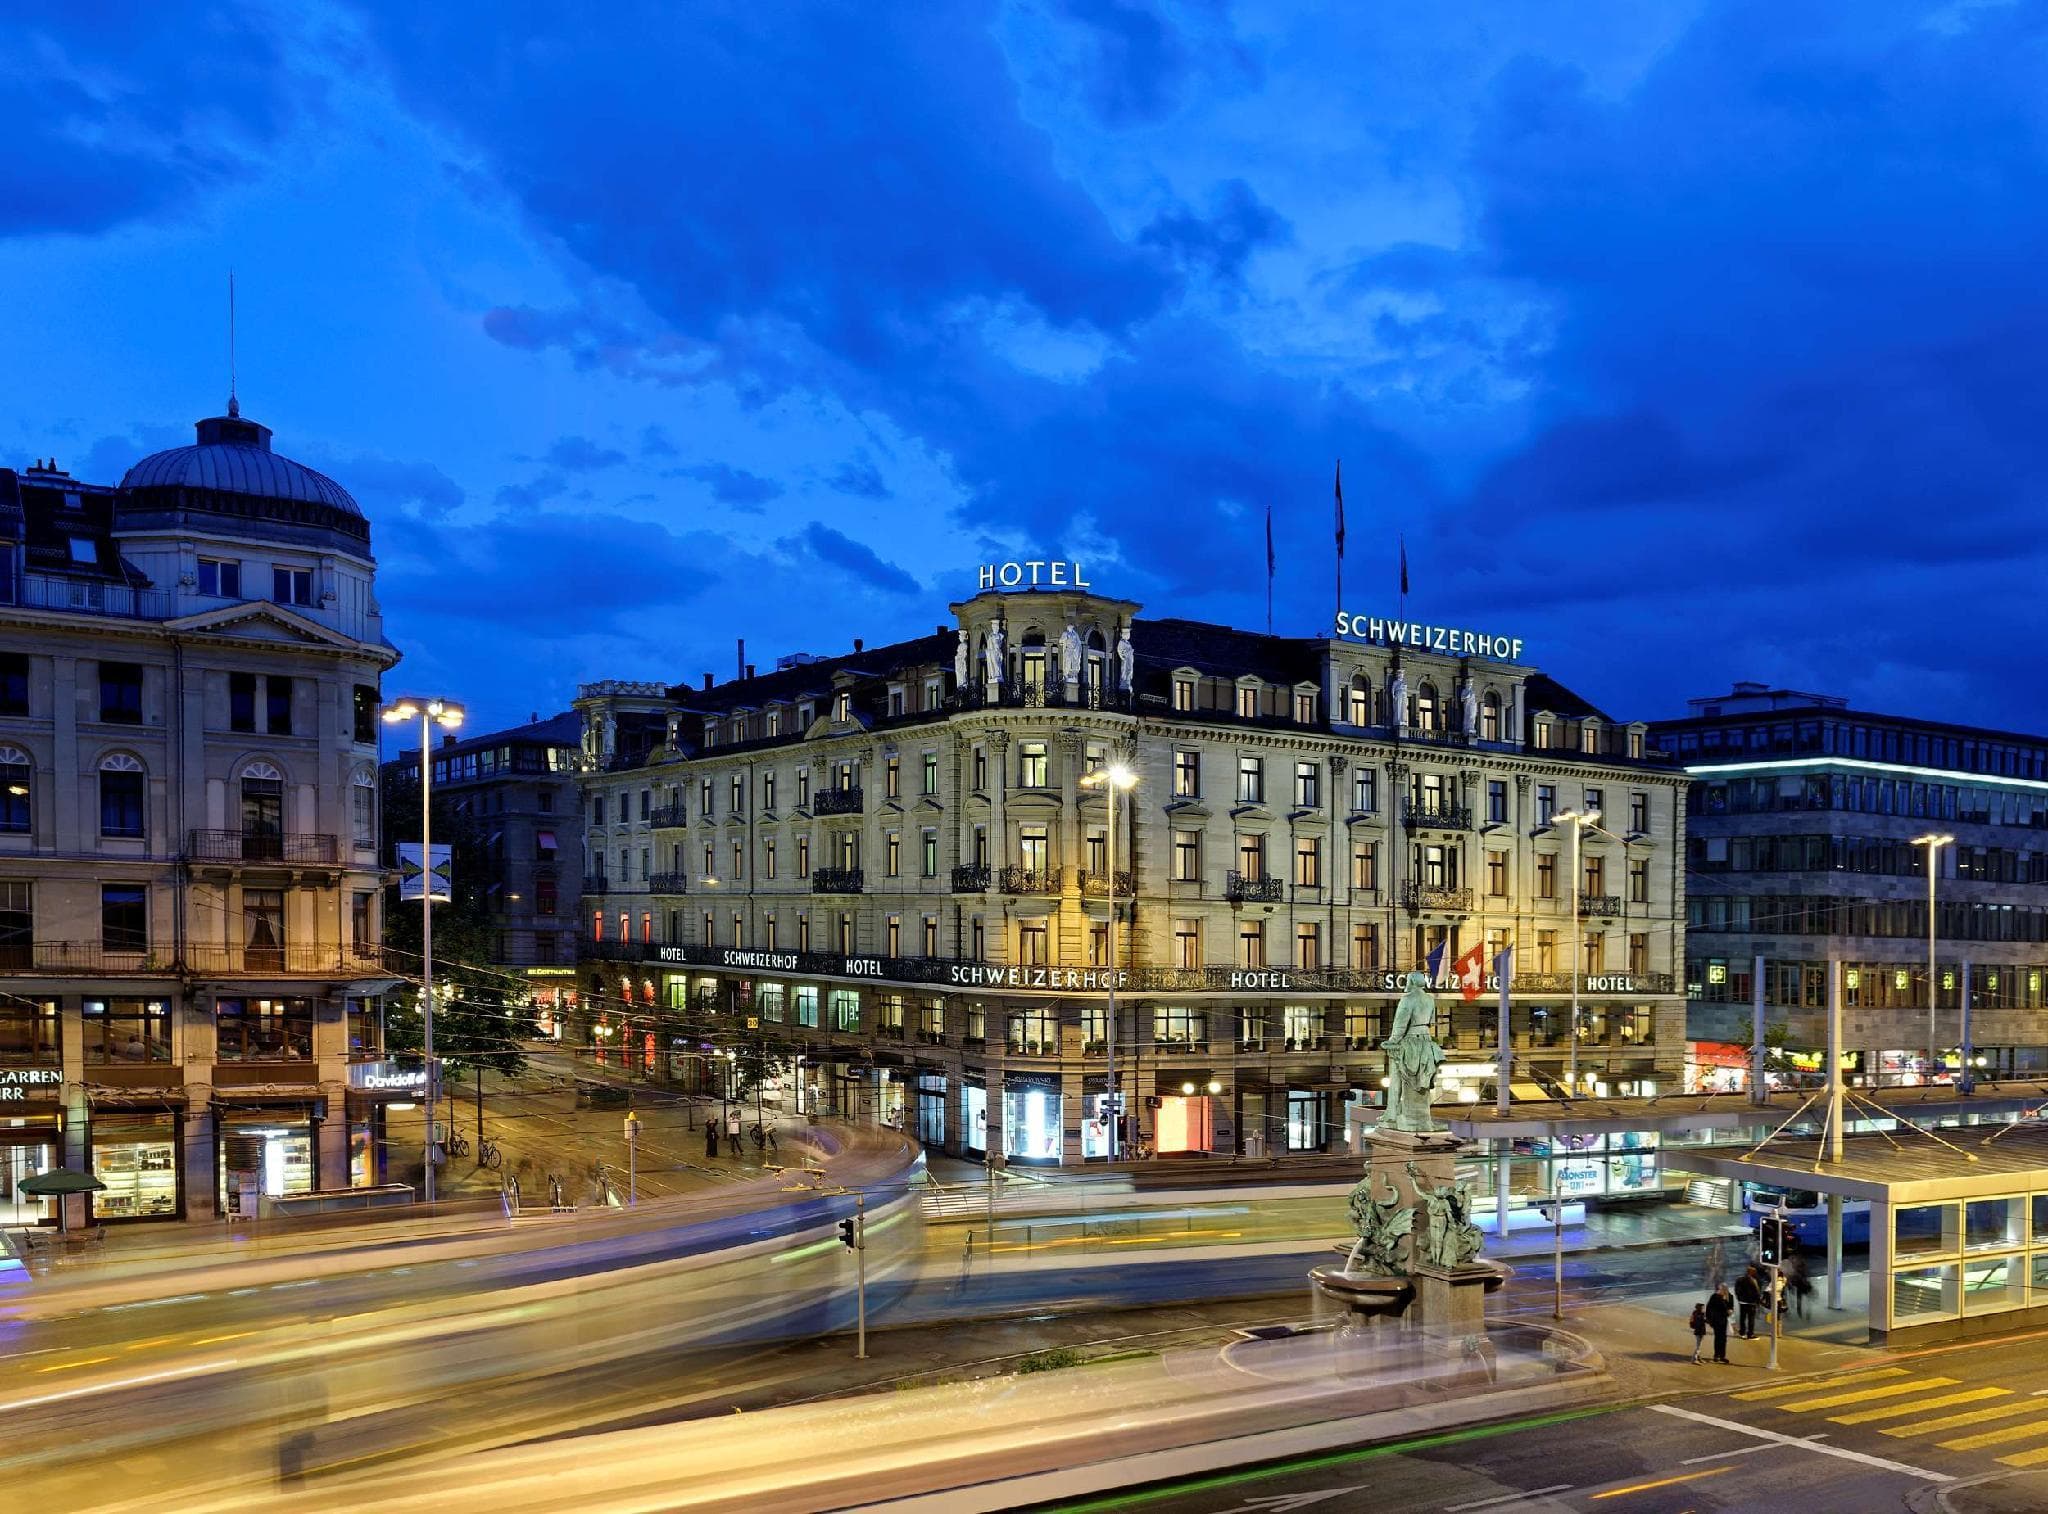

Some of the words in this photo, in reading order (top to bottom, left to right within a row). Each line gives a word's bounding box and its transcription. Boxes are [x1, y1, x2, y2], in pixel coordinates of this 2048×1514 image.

[979, 561, 1091, 589] HOTEL
[1336, 611, 1523, 660] SCHWEIZERHOF
[660, 947, 687, 961] HOTEL
[723, 951, 799, 970] SCHWEIZERHOF
[845, 959, 883, 976] HOTEL
[951, 965, 1127, 988] SCHWEIZERHOF
[1231, 972, 1290, 988] HOTEL
[1587, 976, 1634, 991] HOTEL
